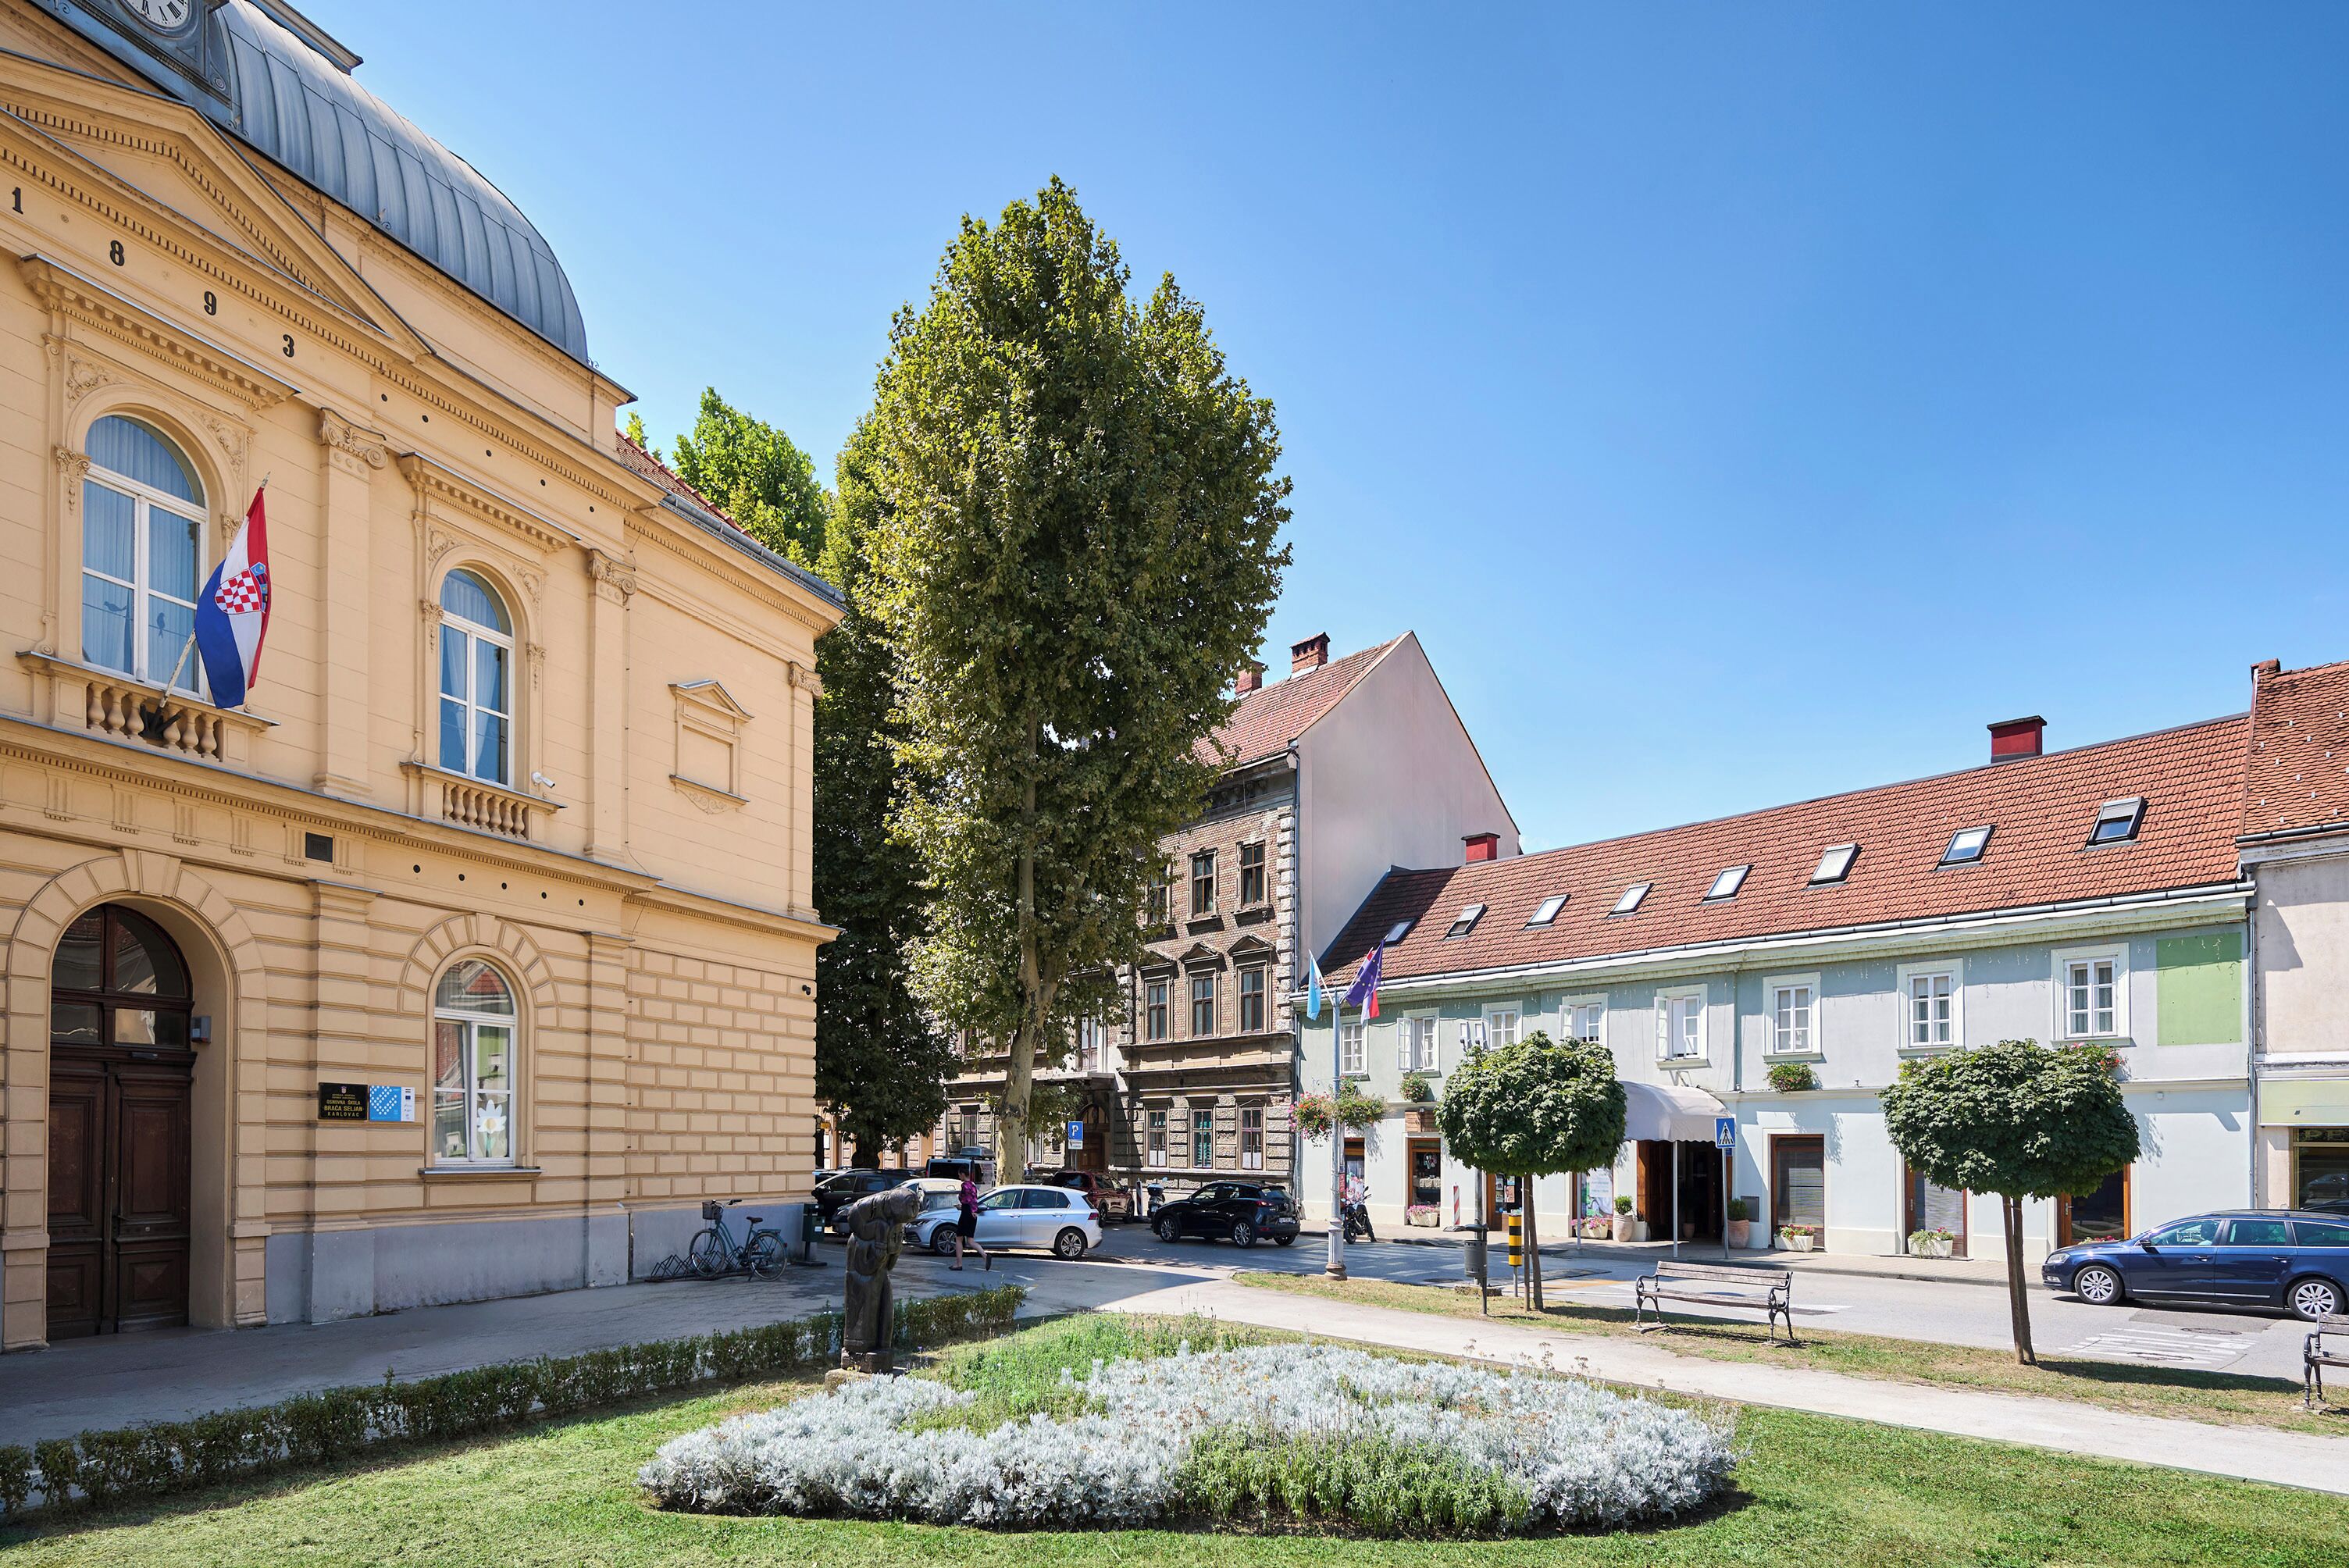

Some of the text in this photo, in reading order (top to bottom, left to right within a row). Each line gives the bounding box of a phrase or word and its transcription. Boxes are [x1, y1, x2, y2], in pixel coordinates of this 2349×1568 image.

[12, 187, 295, 358] 1 8 9 3
[1072, 1125, 1078, 1136] P
